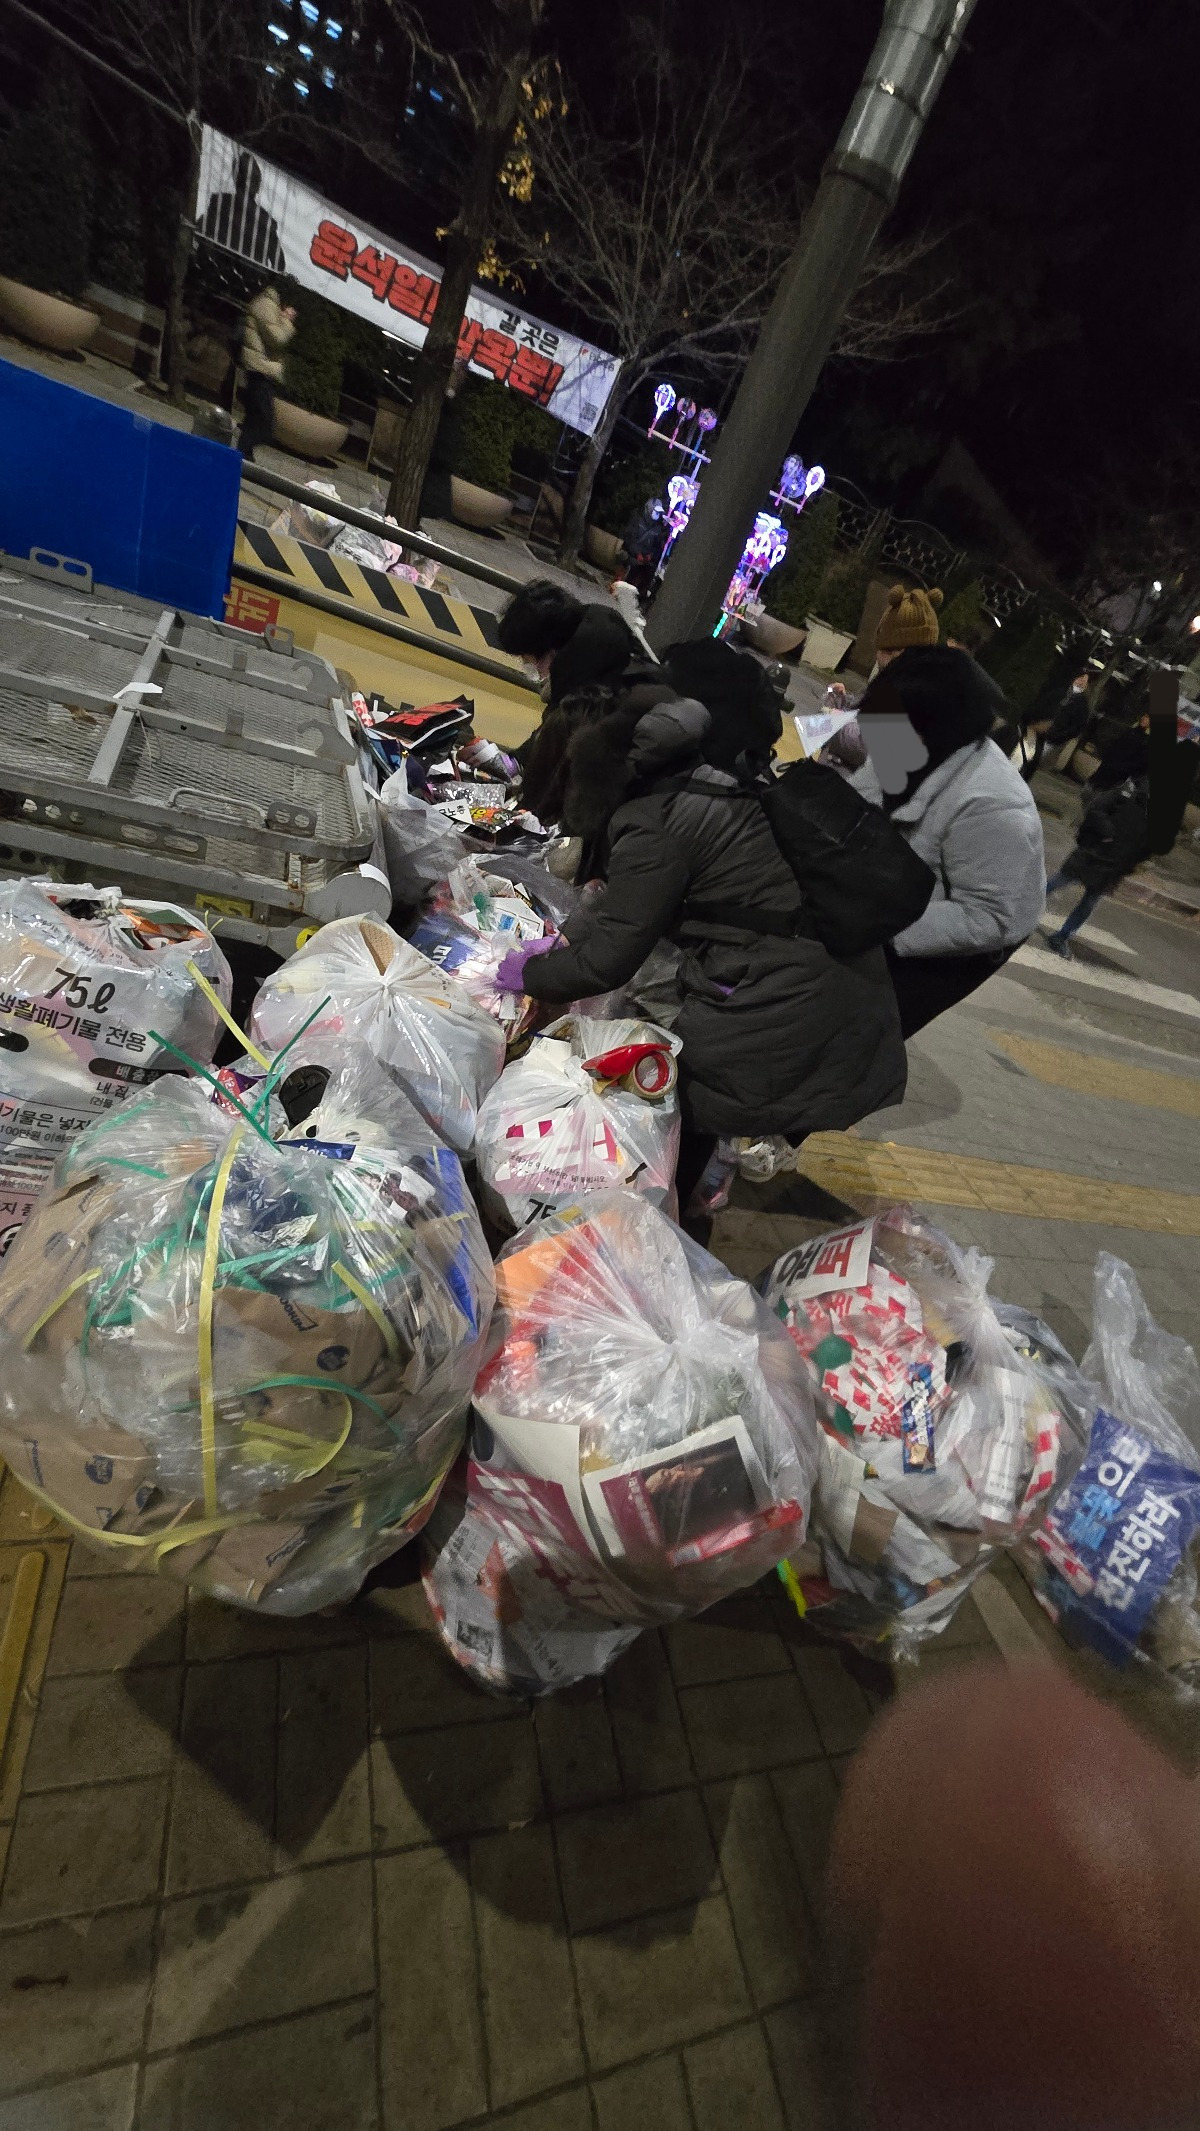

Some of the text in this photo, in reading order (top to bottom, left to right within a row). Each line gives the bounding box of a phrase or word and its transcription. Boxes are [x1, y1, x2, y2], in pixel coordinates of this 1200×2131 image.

[499, 309, 560, 357] 갈 곳은
[0, 991, 147, 1053] 생활폐기물 전용
[0, 1103, 53, 1128] 기물은
